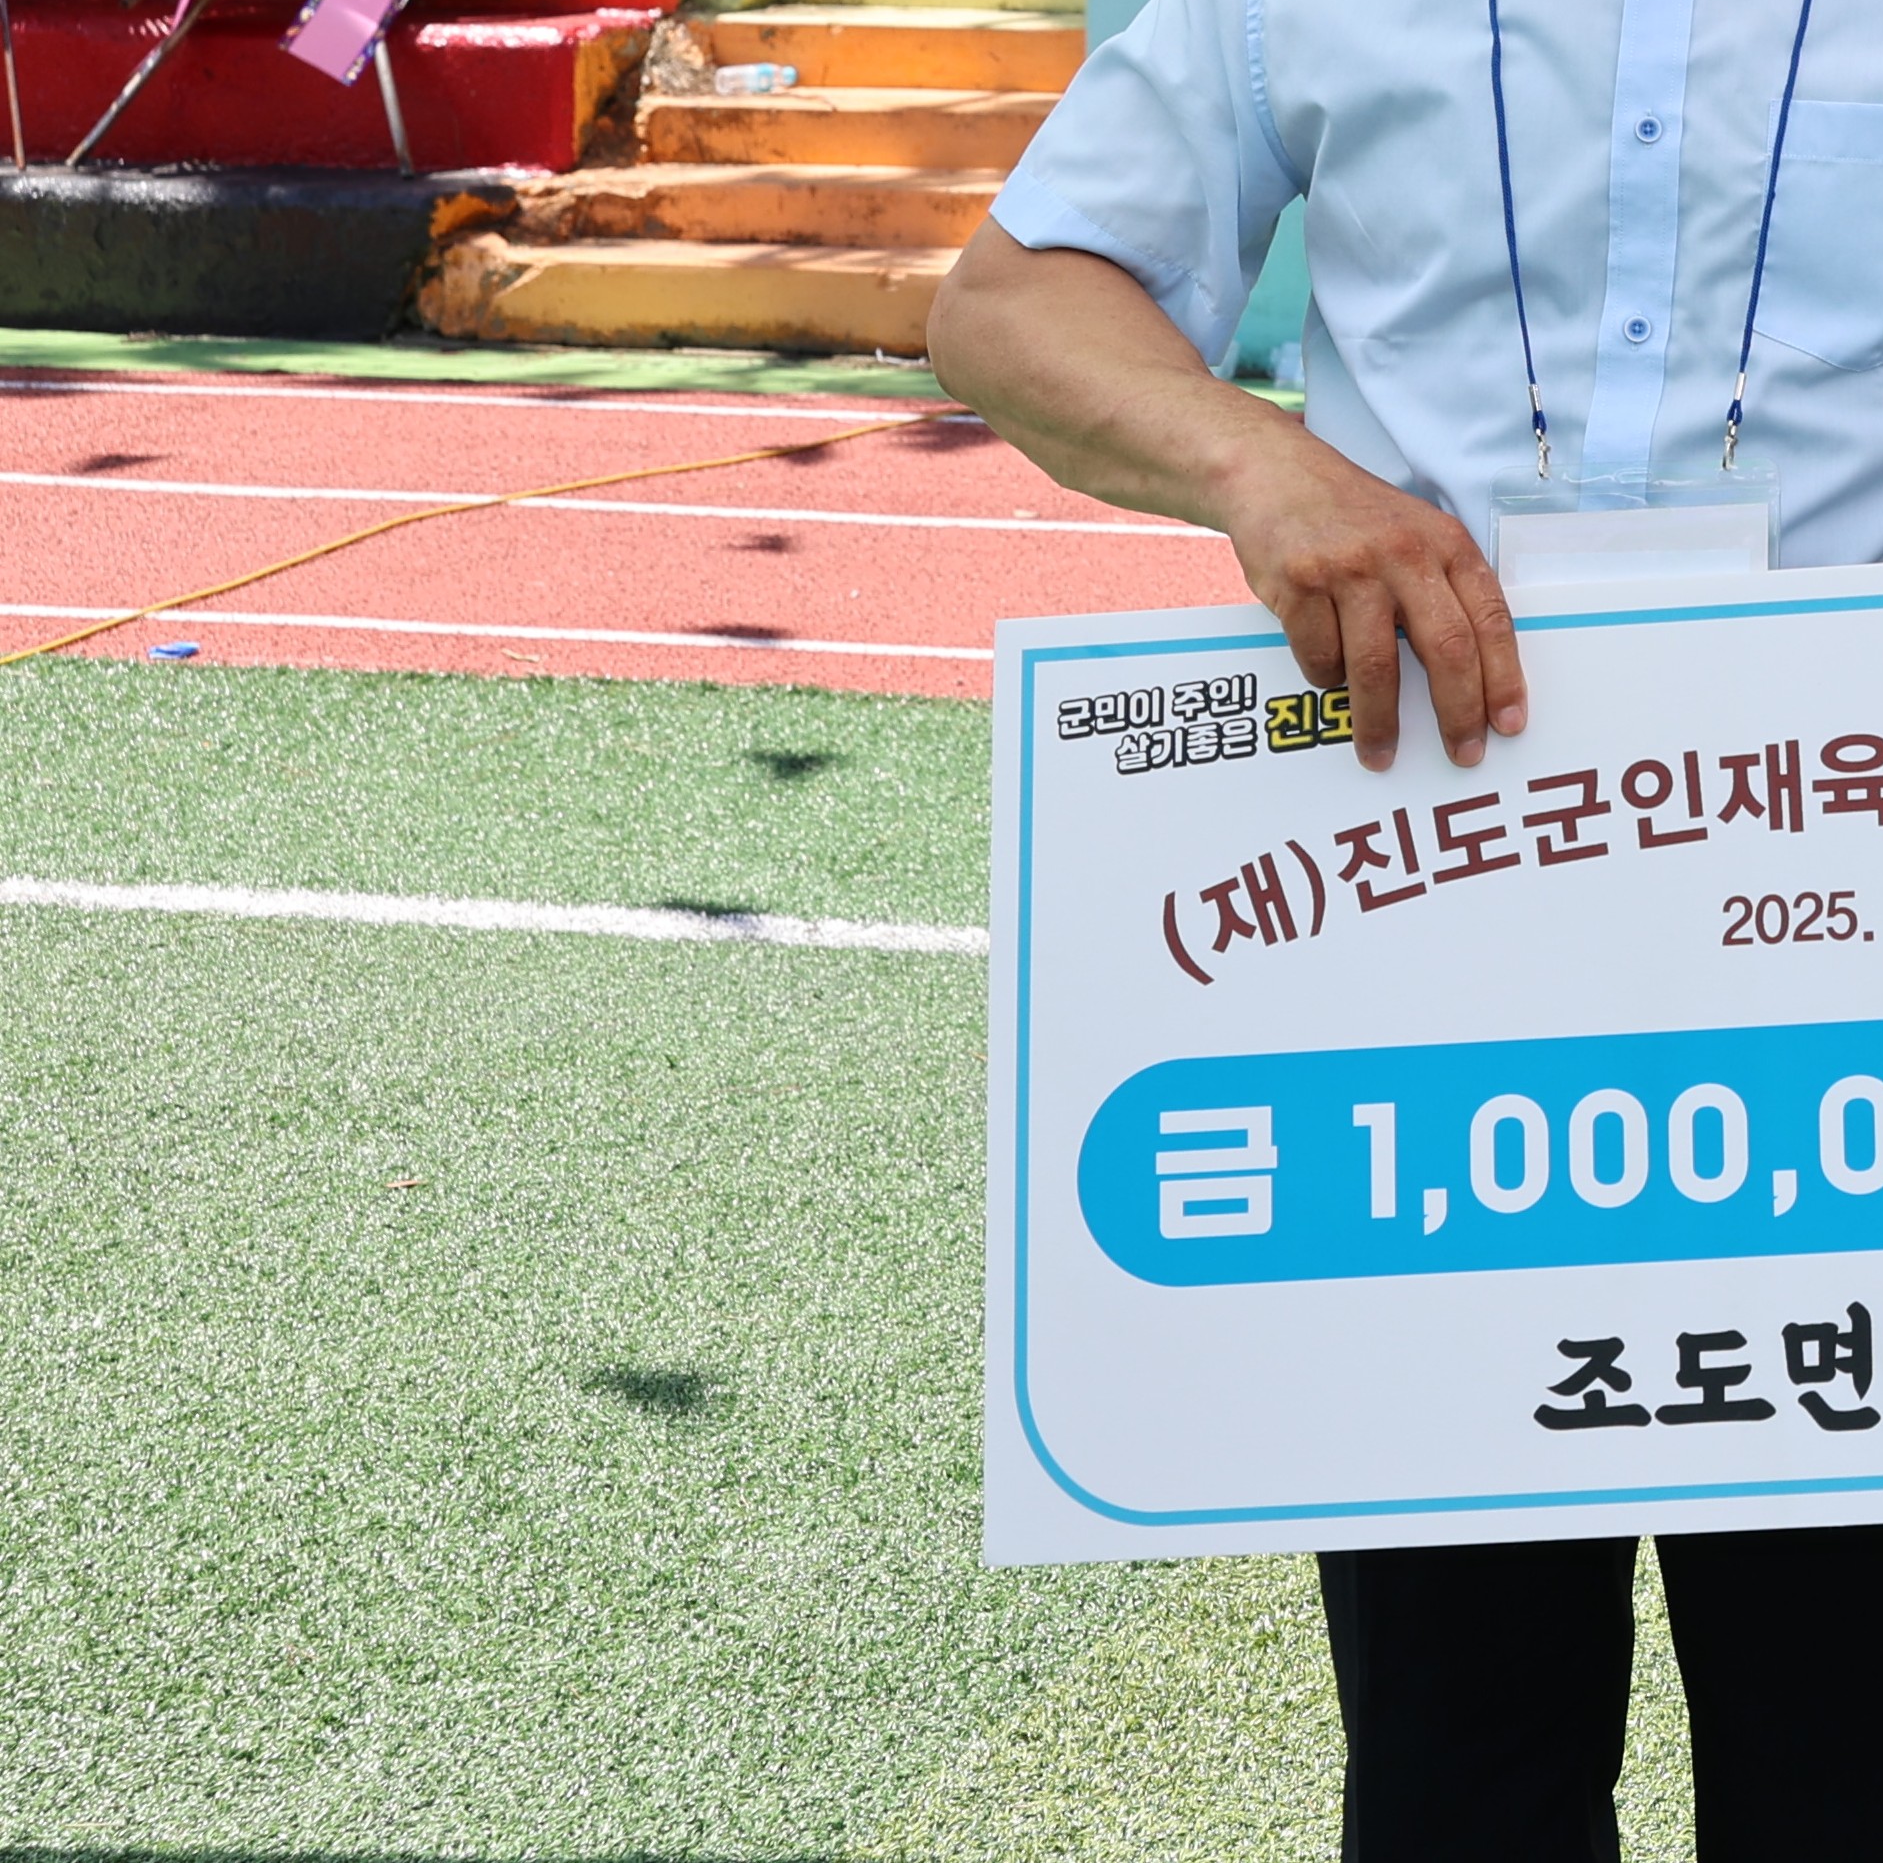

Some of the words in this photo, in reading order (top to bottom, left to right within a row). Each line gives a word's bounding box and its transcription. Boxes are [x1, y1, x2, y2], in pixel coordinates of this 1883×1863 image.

[1057, 685, 1164, 740] 군민이
[1172, 673, 1257, 721] 주인!
[1115, 717, 1257, 775] 살기좋은
[1264, 686, 1354, 753] 진도
[1721, 889, 1876, 947] 2025.
[1154, 1103, 1279, 1241] 금
[1532, 1300, 1882, 1433] 조도면
